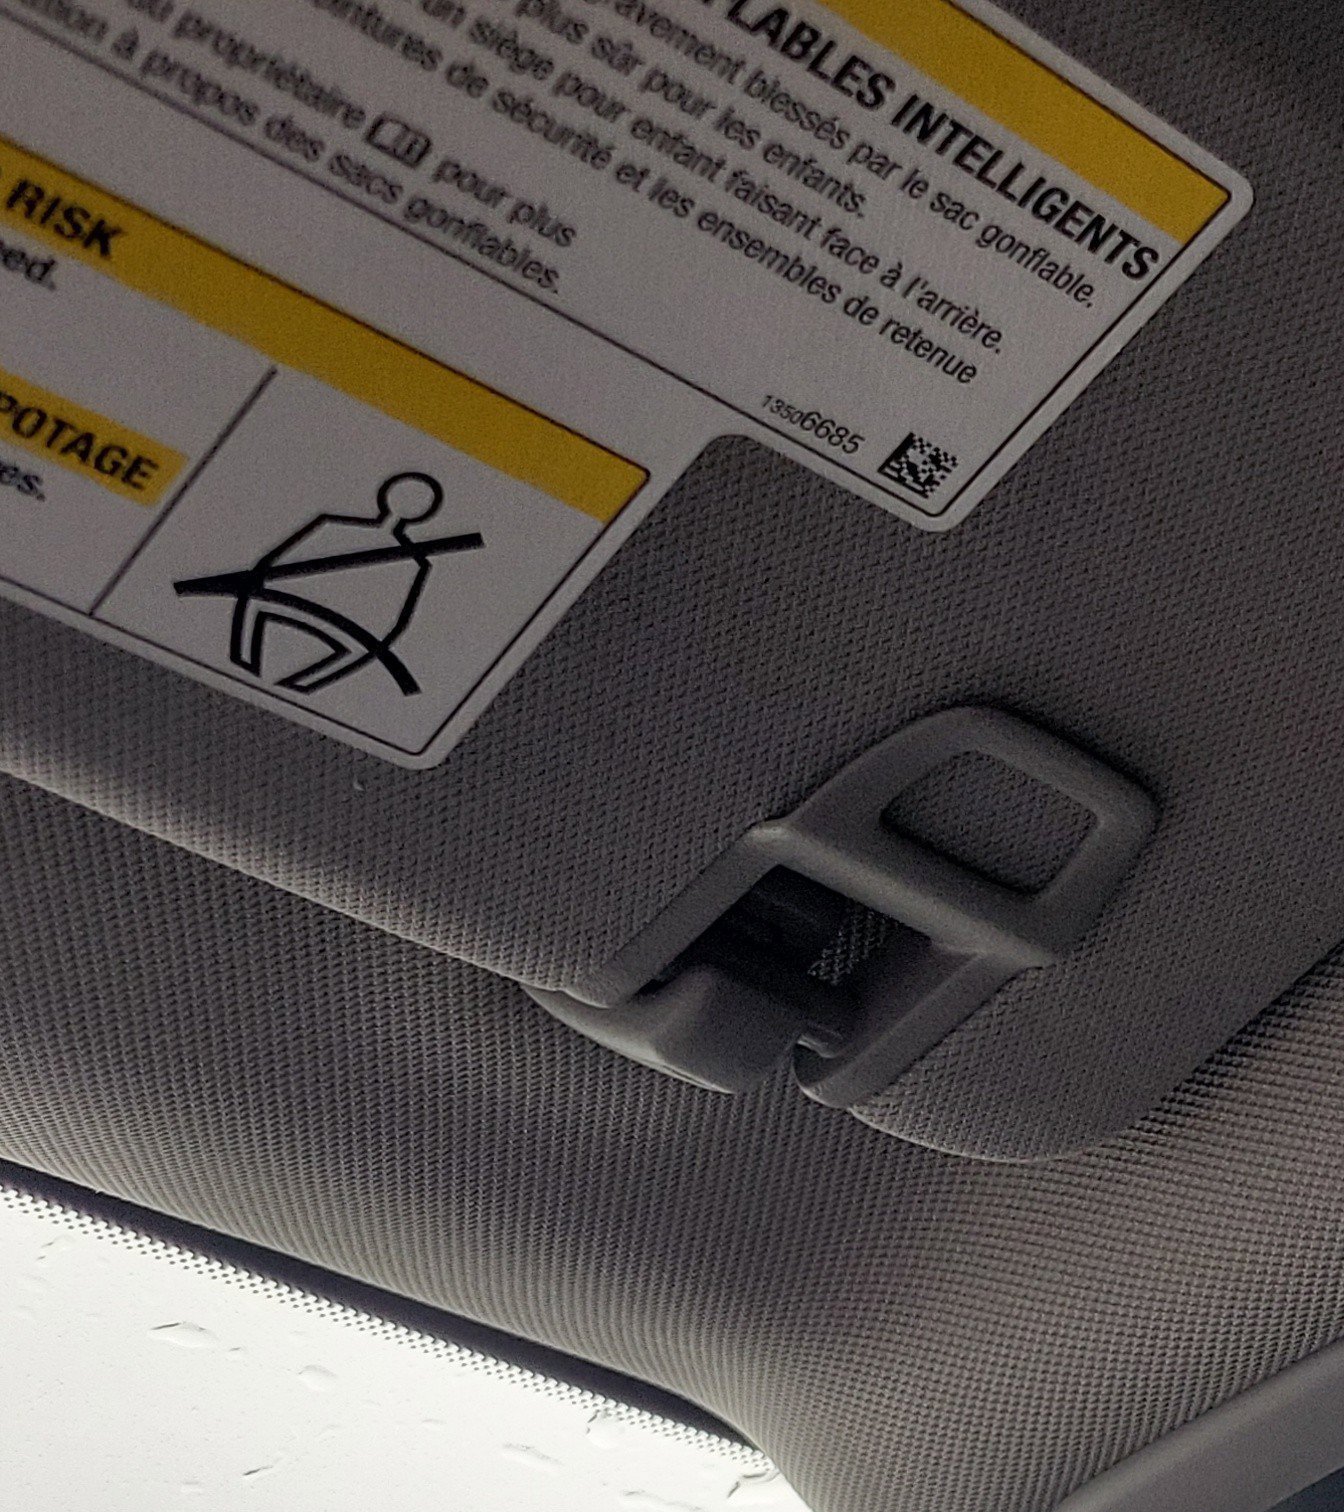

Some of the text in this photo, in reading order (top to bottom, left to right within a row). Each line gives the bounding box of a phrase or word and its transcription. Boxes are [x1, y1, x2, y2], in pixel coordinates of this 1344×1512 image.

[431, 159, 510, 210] pour
[507, 199, 578, 248] plus
[552, 71, 631, 124] pour
[630, 116, 727, 184] enfant
[723, 168, 823, 241] faisant
[819, 226, 880, 276] face
[879, 262, 903, 291] à
[902, 276, 1003, 355] l'arrière.
[613, 0, 1095, 309] avement blessés par le sac gonflable.
[638, 67, 718, 121] pour
[712, 105, 761, 150] les
[762, 142, 867, 219] enfants.
[724, 0, 1160, 280] LABLES INTELLIGENTS
[0, 240, 56, 292] ed.
[5, 178, 125, 259] RISK
[327, 152, 404, 206] sacs
[402, 191, 561, 296] gonflables.
[445, 60, 490, 100] de
[492, 88, 617, 172] sécurité
[615, 163, 652, 193] et
[648, 176, 697, 219] les
[697, 211, 843, 306] ensembles
[842, 293, 880, 327] de
[878, 317, 979, 385] retenue
[761, 394, 867, 455] 13506685
